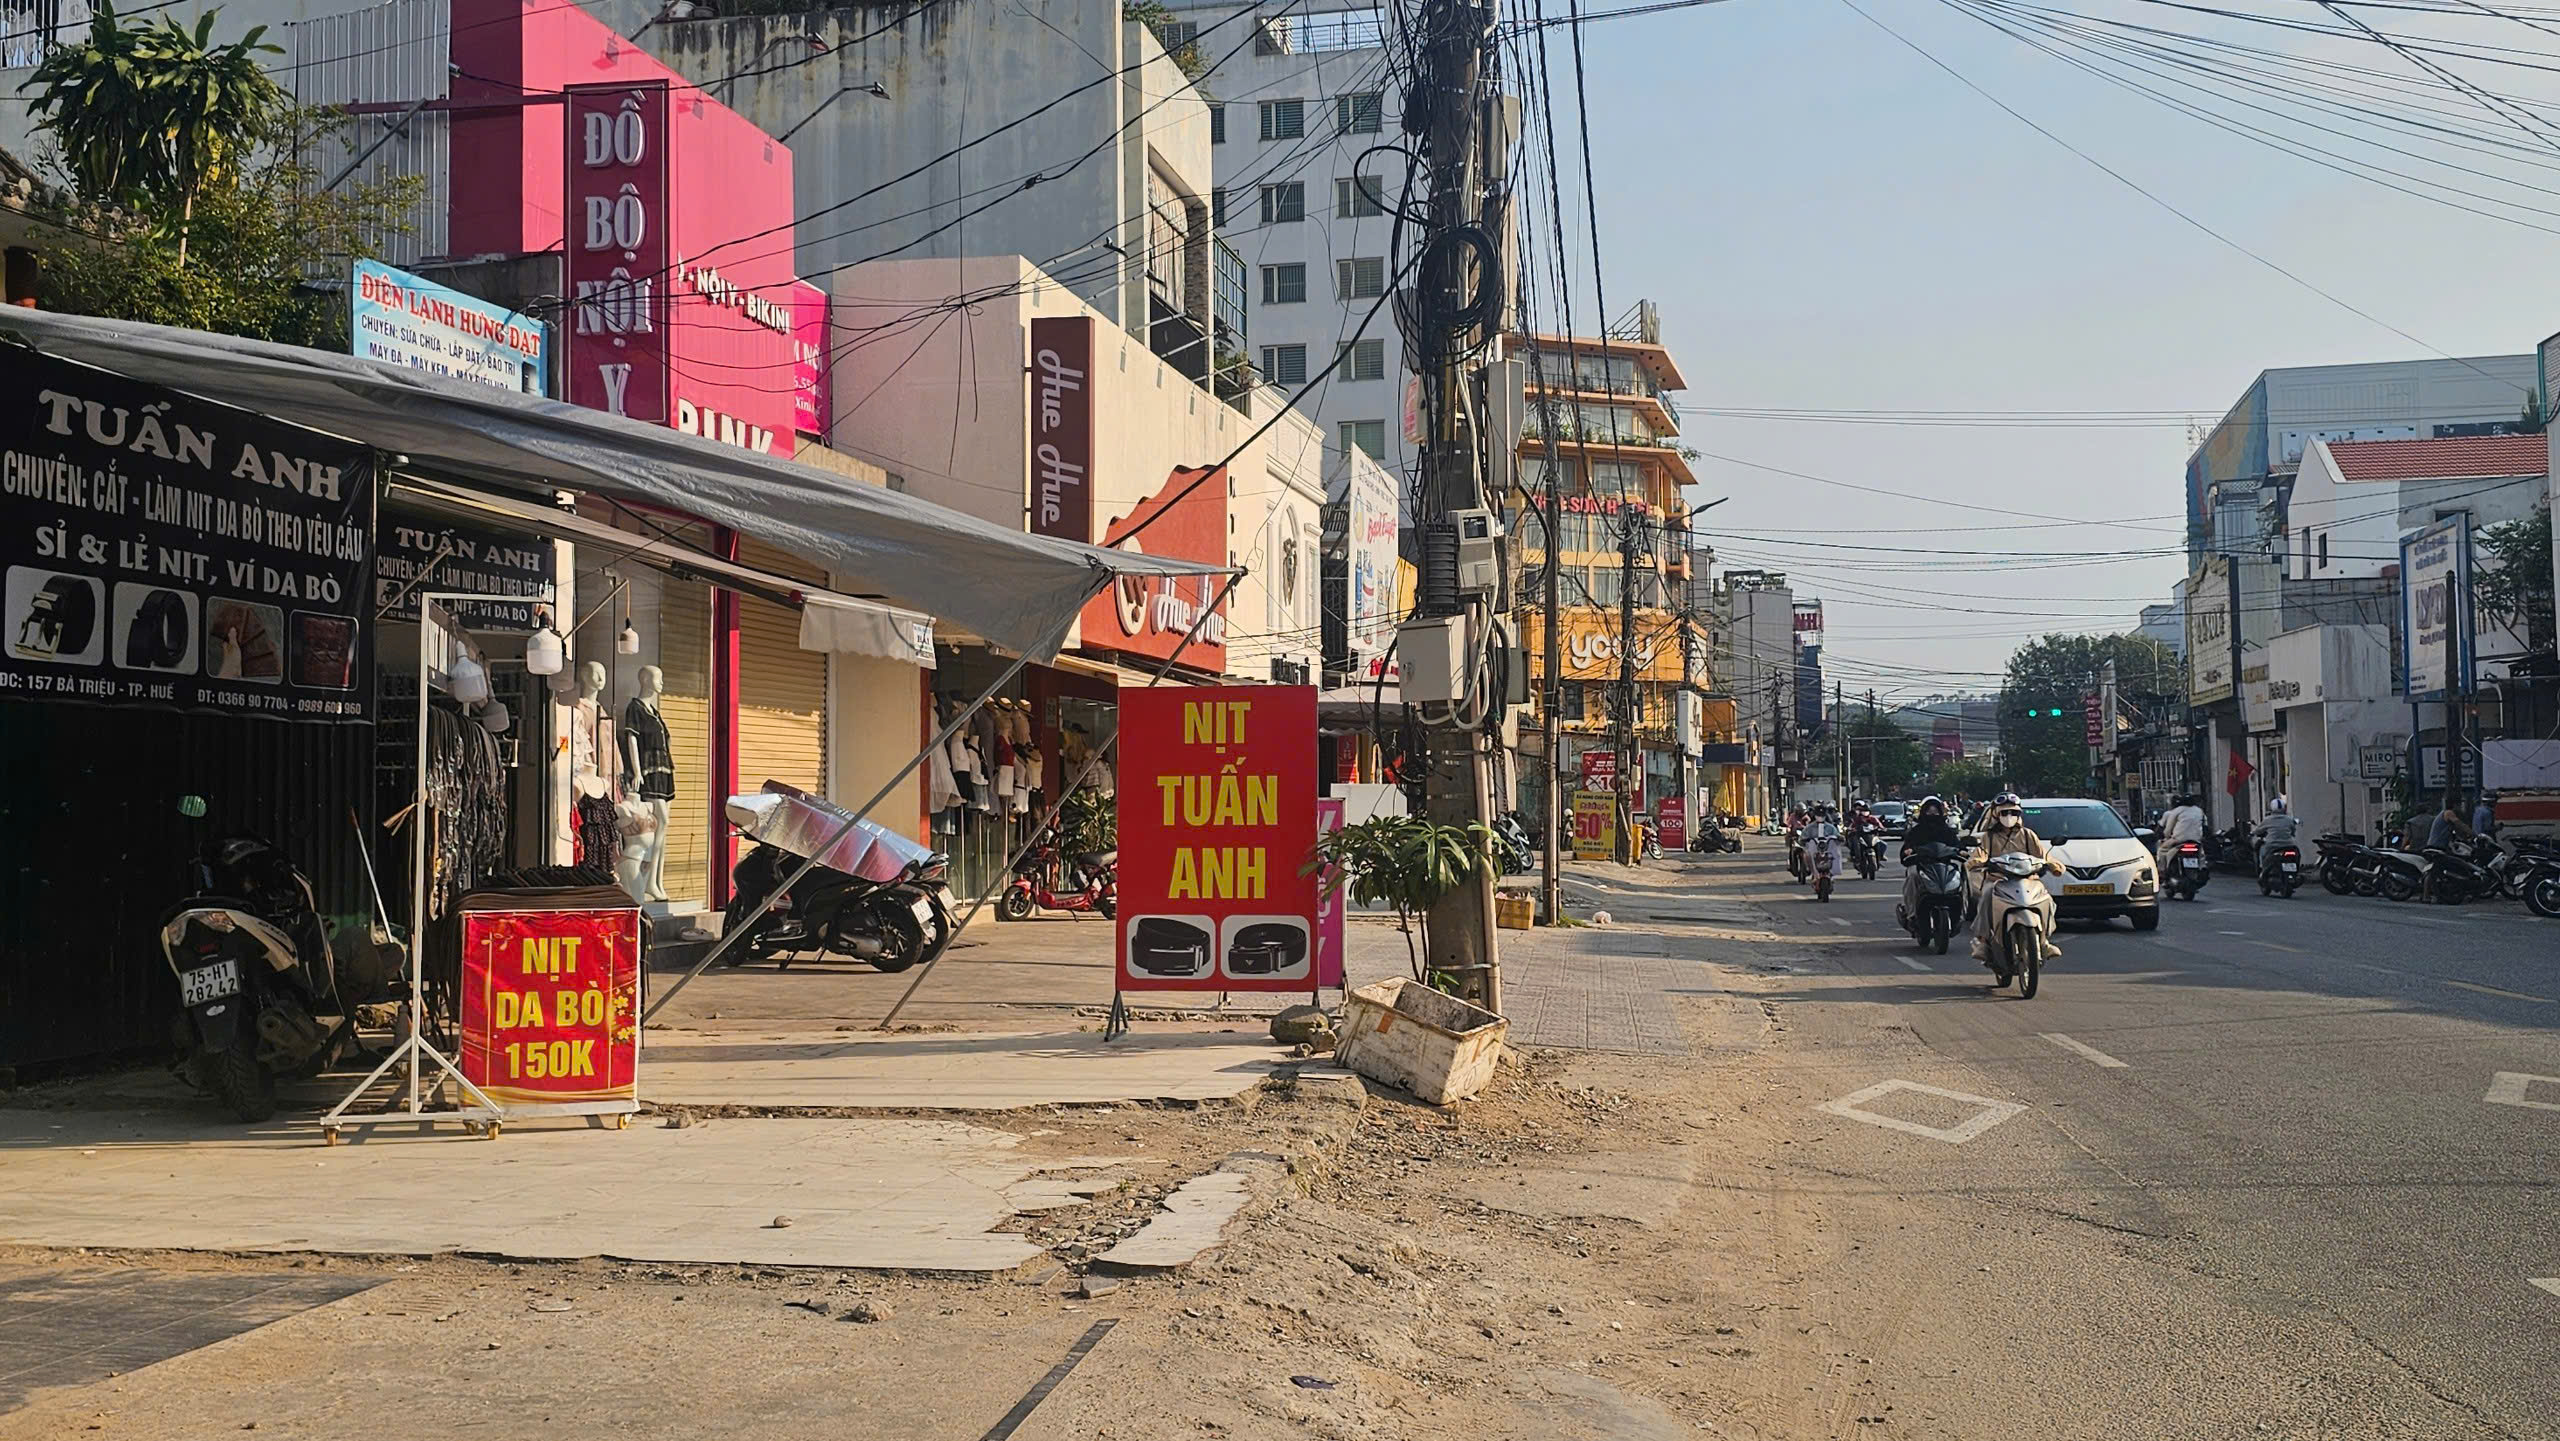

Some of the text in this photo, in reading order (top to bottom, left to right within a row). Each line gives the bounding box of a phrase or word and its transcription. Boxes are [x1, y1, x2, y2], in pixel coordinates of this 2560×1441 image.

[584, 89, 647, 168] ĐỒ
[585, 182, 646, 262] BỘ
[361, 274, 541, 358] ĐIỆN LẠNH HƯNG ĐẠT
[577, 266, 653, 347] NỘI
[747, 292, 790, 335] BIKINI
[599, 363, 632, 417] Y
[39, 389, 342, 501] TUẤN ANH
[1037, 349, 1084, 528] Hue Hue
[4, 450, 87, 508] CHUYÊN:
[93, 458, 128, 515] CẮT
[145, 474, 181, 526] LÀM
[186, 488, 213, 540] NỊT
[216, 497, 238, 538] DA
[242, 497, 262, 543] BÒ
[266, 509, 302, 551] THEO
[306, 513, 332, 557] YÊU
[335, 515, 363, 563] CẦU
[35, 519, 341, 604] SỈ & LẺ NỊT, VÍ DA BÒ
[395, 526, 541, 571] TUẤN ANH
[494, 604, 510, 620] DA
[512, 605, 528, 622] BÒ
[27, 675, 53, 691] 157
[56, 674, 75, 692] BÀ
[79, 677, 116, 698] TRIỆU
[128, 682, 147, 698] TP.
[150, 682, 175, 700] HUẾ
[218, 691, 245, 706] 0366
[249, 694, 261, 708] 90
[298, 699, 323, 713] 0989
[1184, 701, 1252, 754] NỊT
[2365, 753, 2392, 762] MIRO
[1157, 757, 1278, 826] TUẤN
[1575, 812, 1614, 840] 50%
[1168, 847, 1266, 899] ANH
[189, 963, 228, 986] 75-H1
[521, 936, 582, 982] NỊT
[496, 980, 605, 1028] DA BÒ
[505, 1039, 596, 1079] 150K
